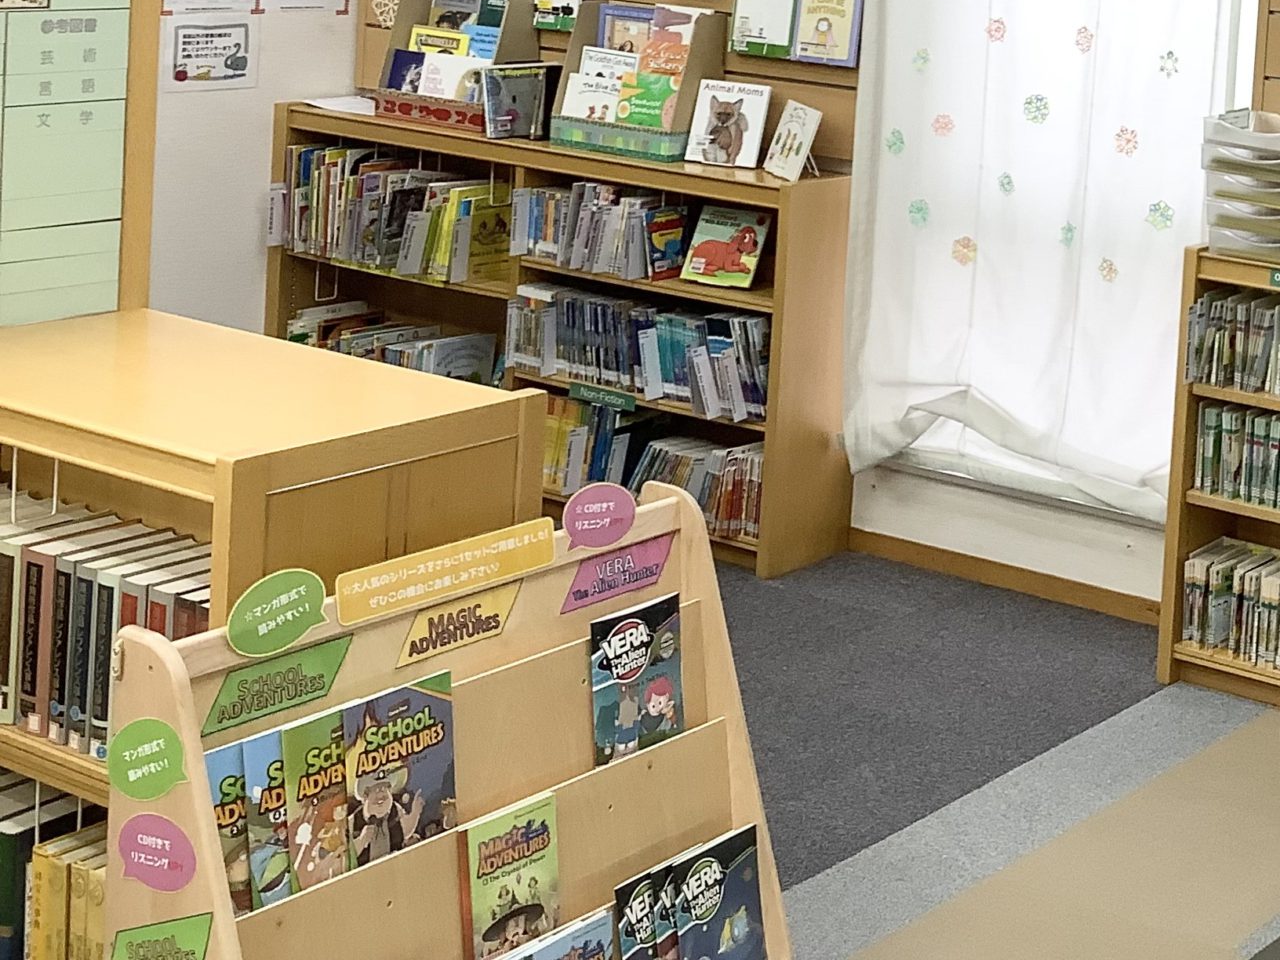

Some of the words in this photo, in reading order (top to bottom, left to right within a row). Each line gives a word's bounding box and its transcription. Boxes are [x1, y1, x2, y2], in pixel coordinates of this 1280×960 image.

[704, 83, 734, 96] Animal
[737, 87, 764, 101] Moms
[579, 386, 627, 407] Non-Fiction
[573, 586, 589, 601] The
[591, 577, 619, 598] Alien
[620, 564, 659, 586] Hunter
[595, 555, 635, 579] VERA
[408, 612, 500, 657] ADVENTURES
[427, 603, 482, 636] MAGIC
[603, 625, 648, 658] VERA
[621, 646, 646, 662] Alien
[237, 664, 306, 700] SCHOOL
[612, 659, 648, 680] Hunter
[217, 673, 326, 723] ADVENTURES
[365, 707, 435, 749] SCHOOL
[305, 743, 346, 775] SCH
[356, 724, 445, 778] ADVENTURES
[477, 830, 551, 879] ADVENTURES
[490, 873, 501, 884] The
[681, 861, 723, 900] VERA
[698, 885, 720, 903] Alien
[691, 897, 722, 919] Hunter
